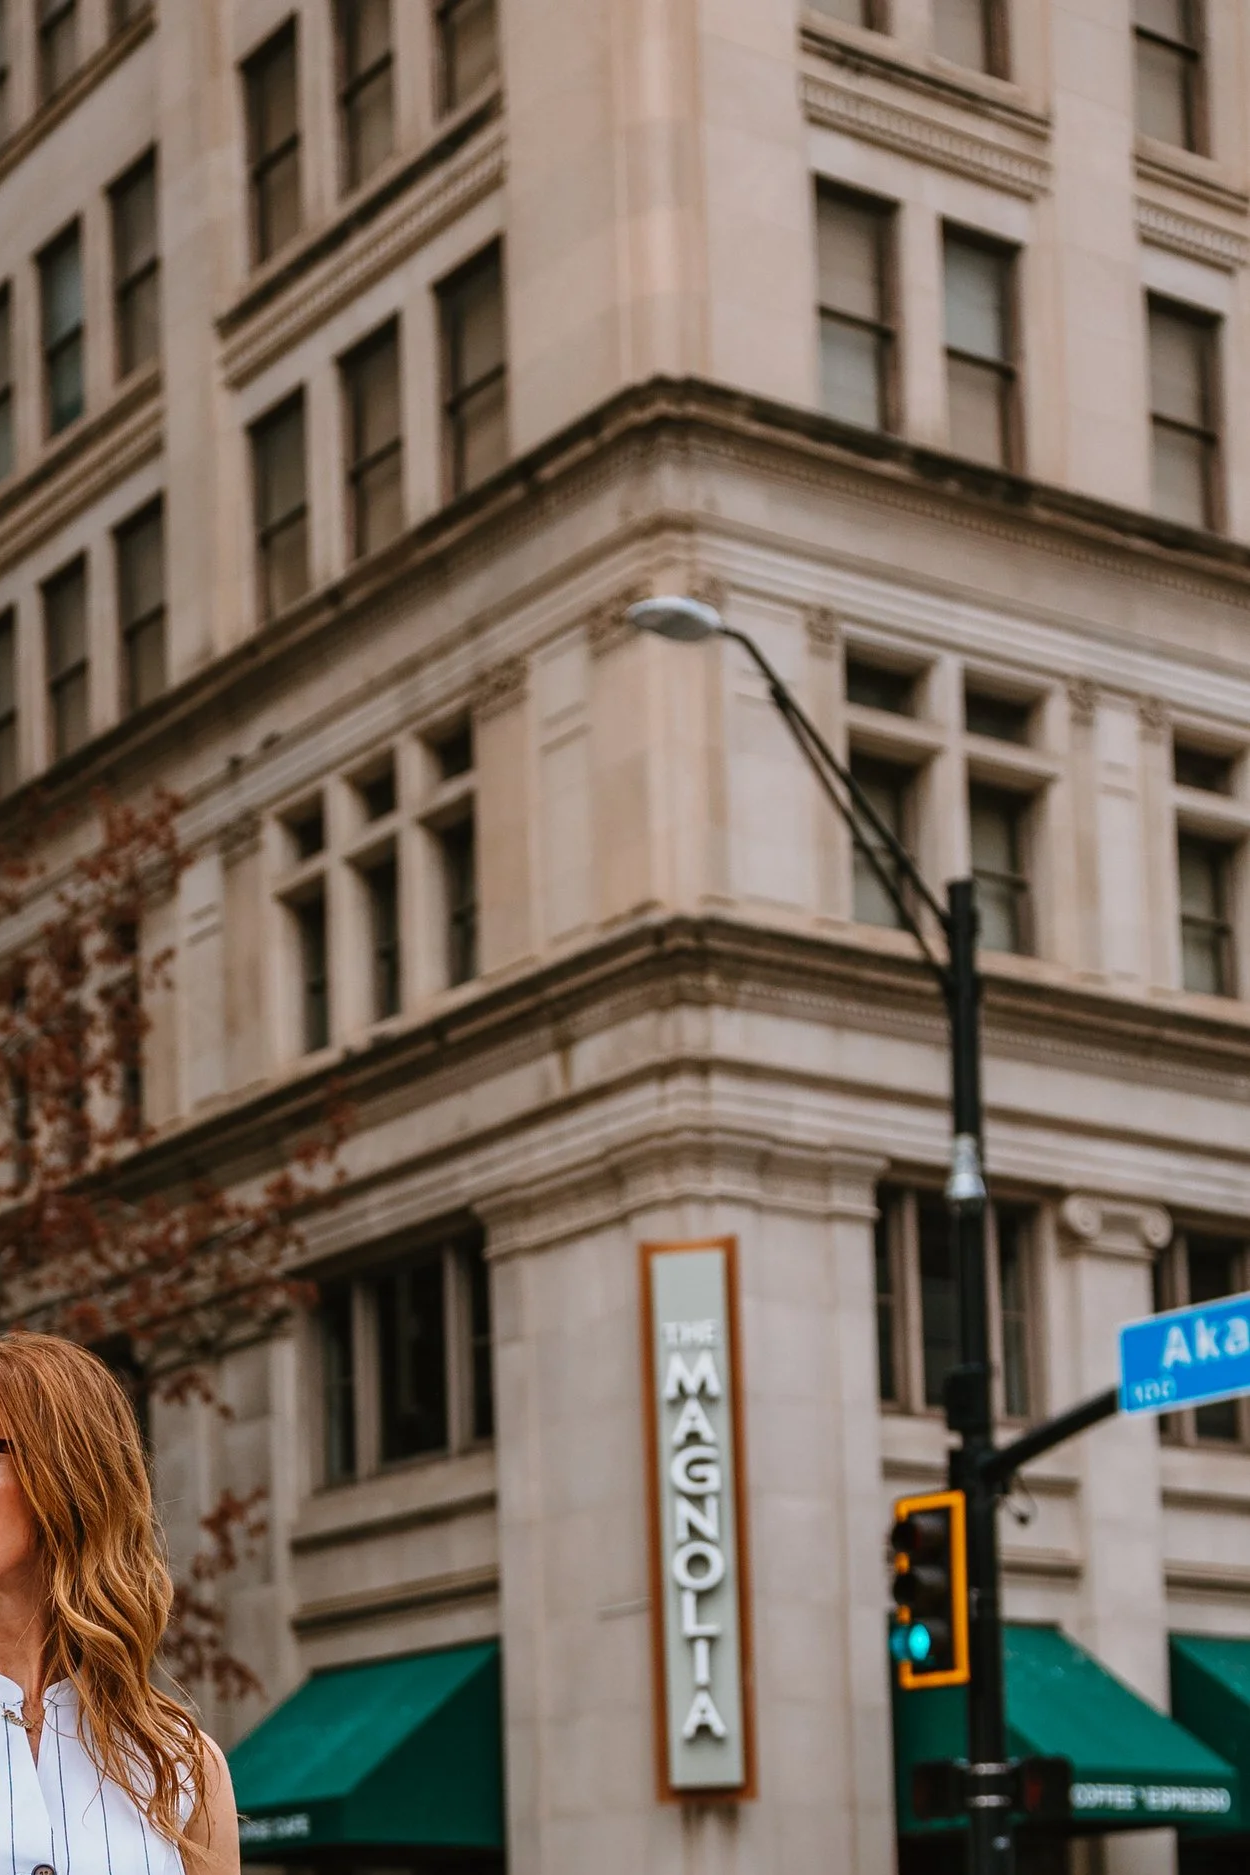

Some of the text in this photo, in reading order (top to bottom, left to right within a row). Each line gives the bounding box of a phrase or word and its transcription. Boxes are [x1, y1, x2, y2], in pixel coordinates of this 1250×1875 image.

[661, 1319, 720, 1344] THE
[1162, 1317, 1250, 1369] Aka
[662, 1350, 728, 1741] MAGNOLIA
[1070, 1783, 1136, 1811] COFFEE
